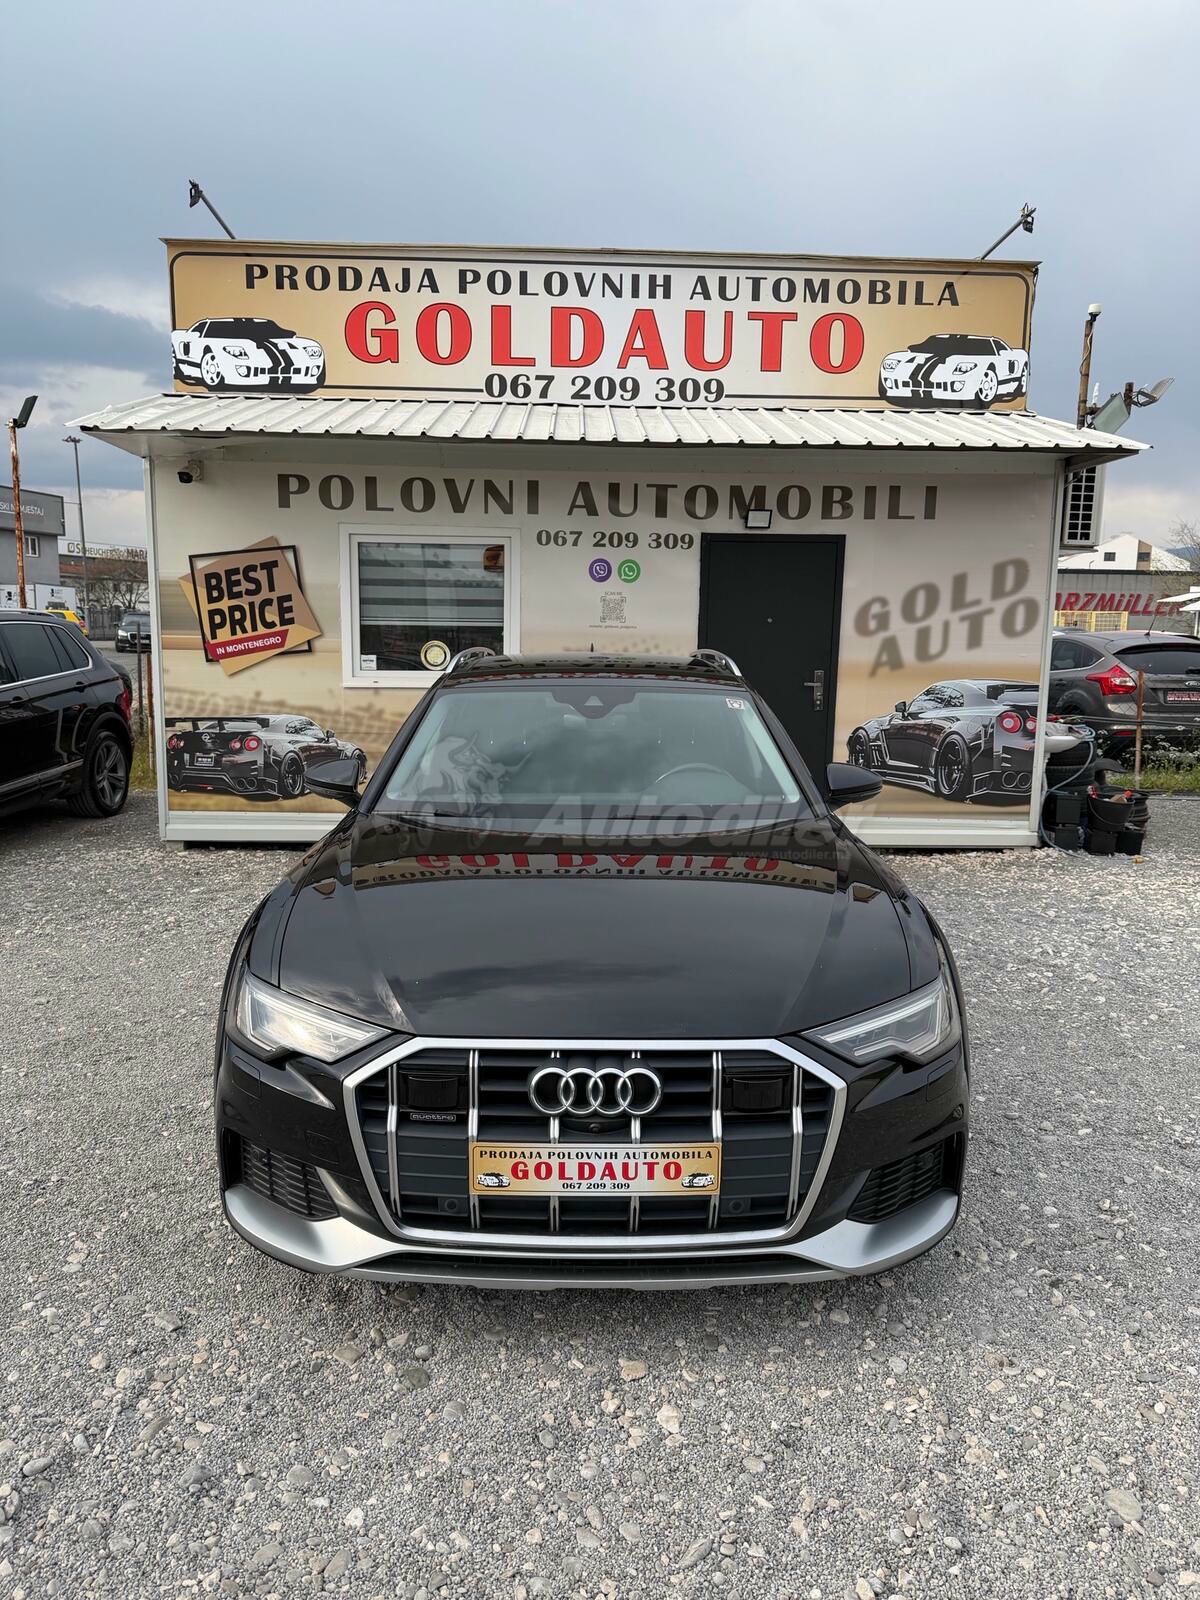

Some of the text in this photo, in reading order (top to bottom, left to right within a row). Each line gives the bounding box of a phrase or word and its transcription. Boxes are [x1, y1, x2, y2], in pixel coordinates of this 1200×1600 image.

[245, 263, 960, 307] PRODAJA POLOVNIH AUTOMOBILA
[344, 300, 865, 375] GOLDAUTO
[484, 373, 726, 403] 067 209 309
[277, 473, 938, 521] POLOVNI AUTOMOBILI
[536, 529, 695, 550] 067 209 309
[204, 559, 279, 605] BEST
[853, 557, 1030, 637] GOLD
[207, 593, 295, 640] PRICE
[869, 596, 1041, 678] AUTO
[216, 636, 282, 655] IN MONTENEGRO
[479, 1150, 713, 1160] PRODAJA POLOVNIH AUTOMOBILA
[511, 1161, 682, 1181] GOLDAUTO
[562, 1182, 630, 1190] 067 209 309
